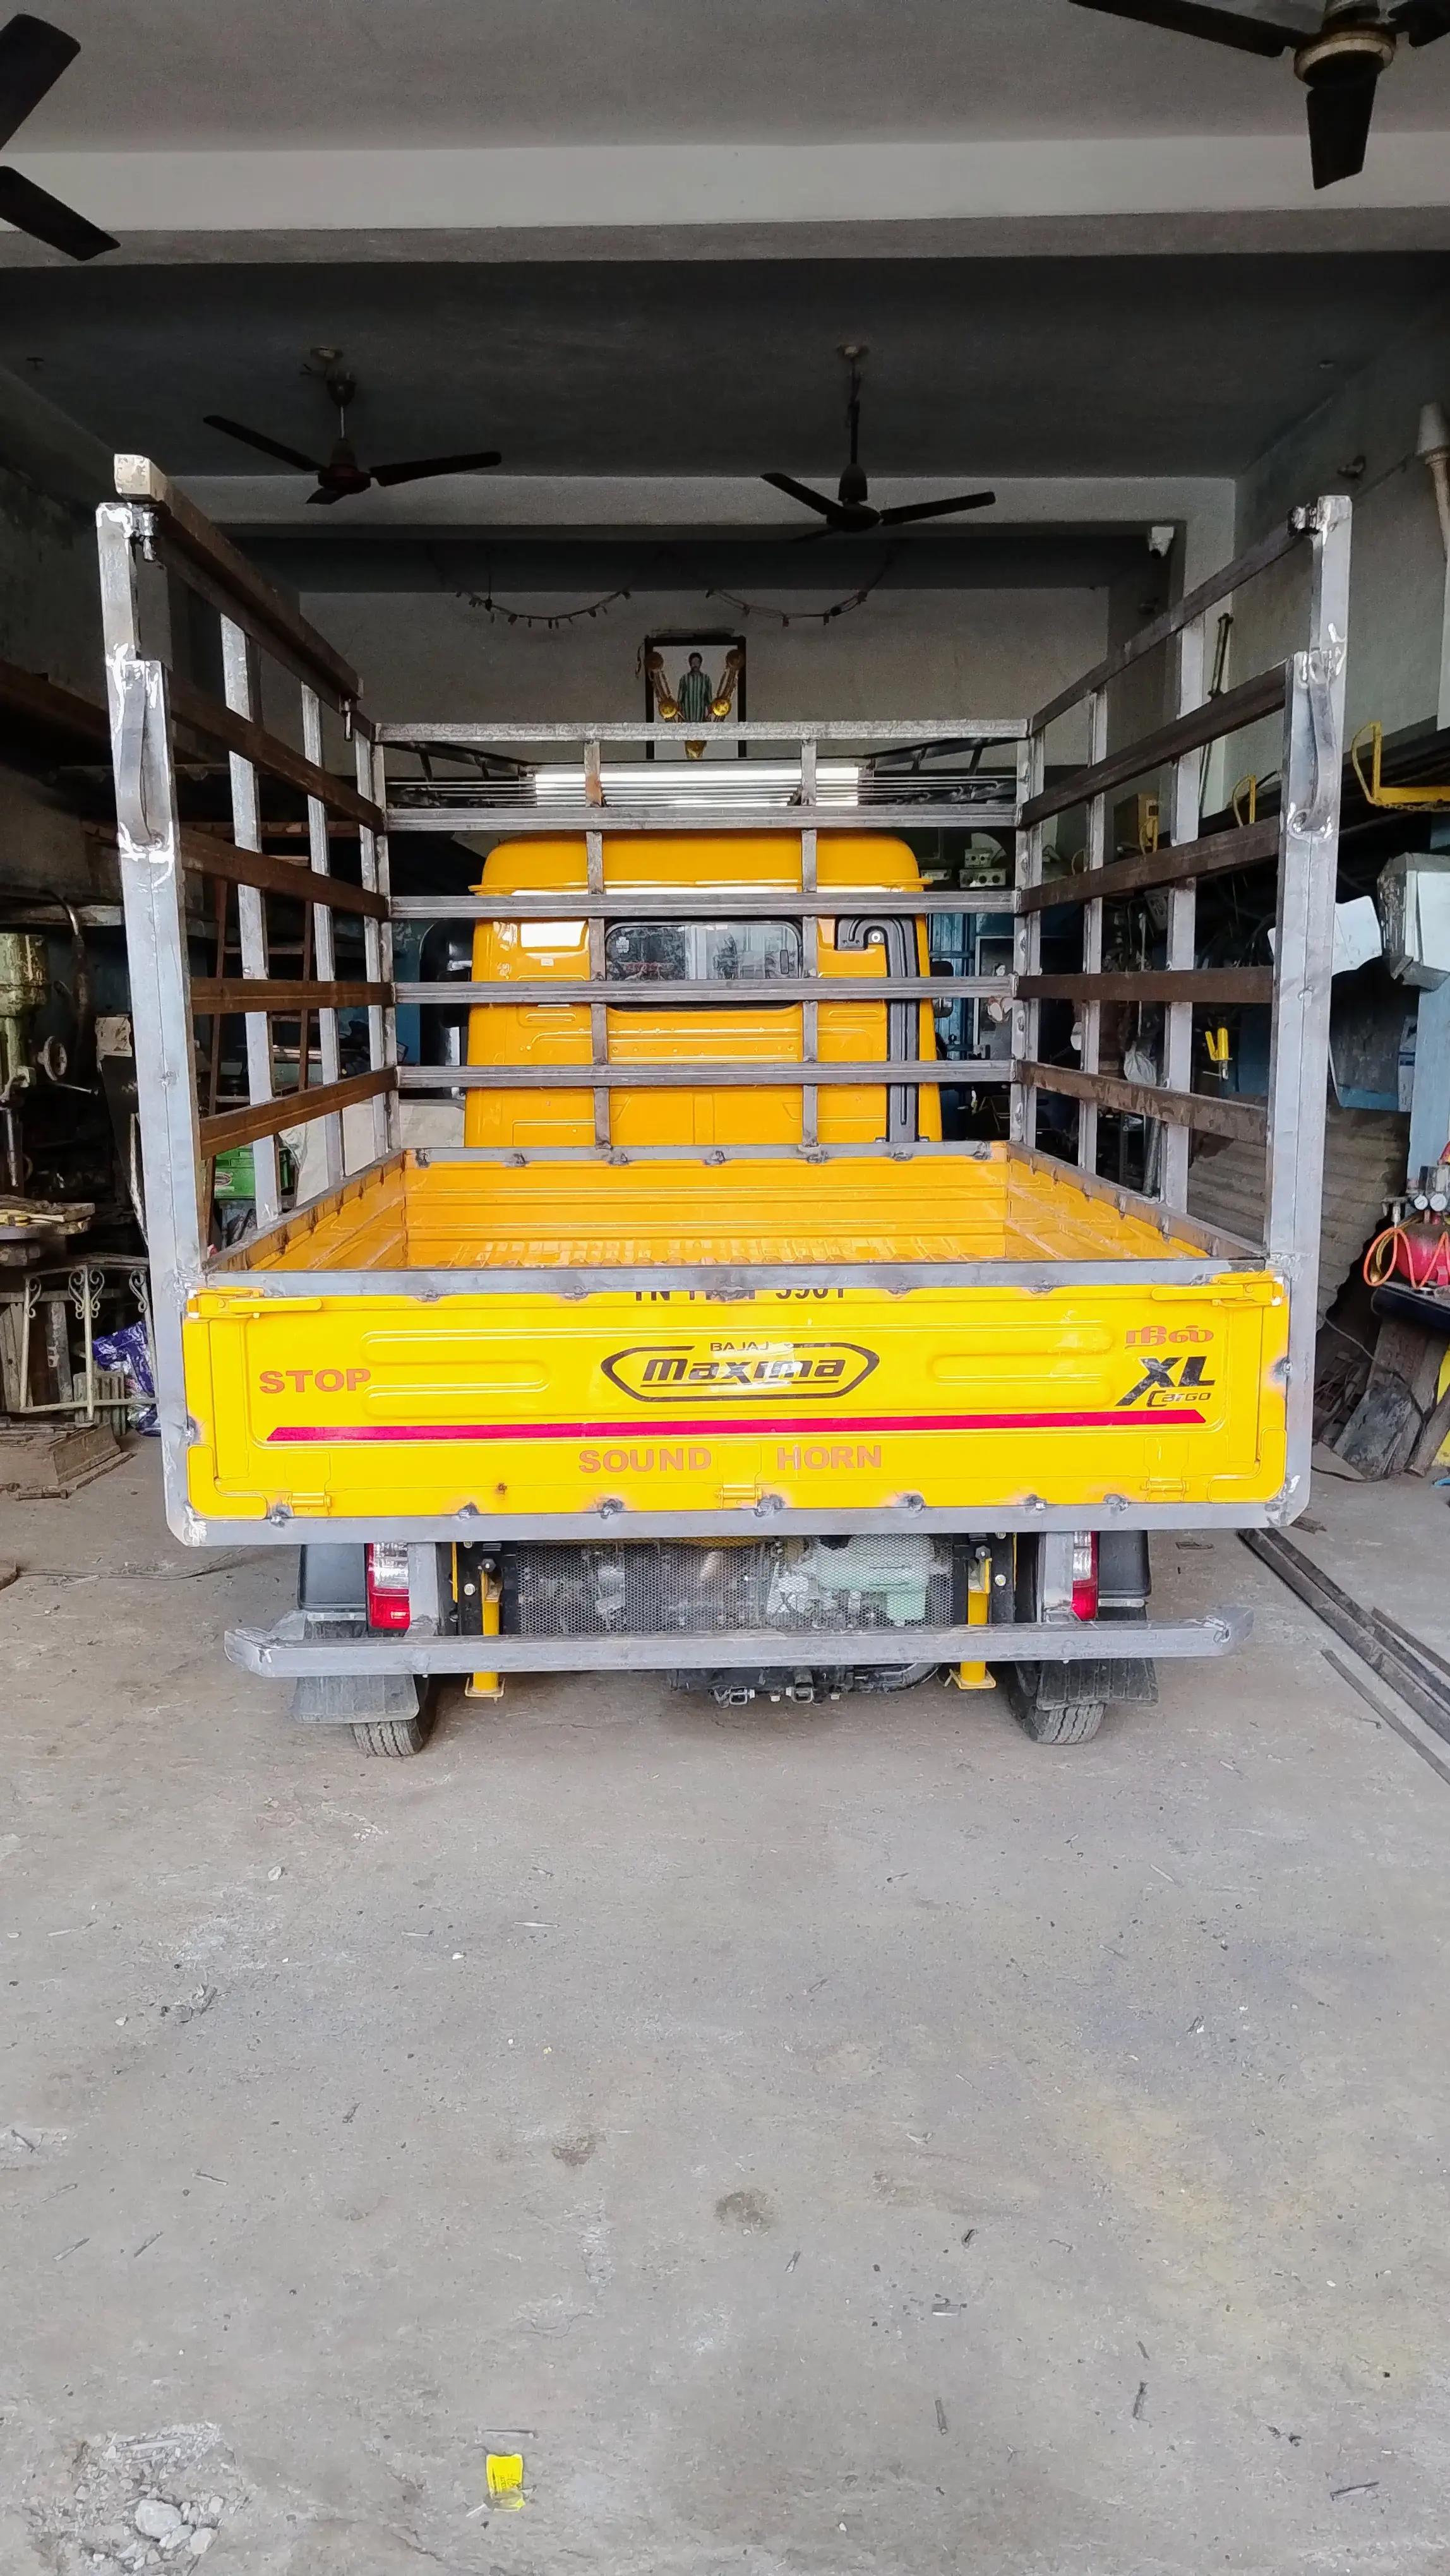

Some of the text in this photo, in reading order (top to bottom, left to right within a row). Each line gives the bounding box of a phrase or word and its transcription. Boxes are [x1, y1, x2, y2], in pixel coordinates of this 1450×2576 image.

[710, 1342, 770, 1352] BAJAJ
[1125, 1325, 1214, 1349] நில்
[260, 1368, 371, 1394] STOP
[1114, 1356, 1216, 1407] XL
[578, 1445, 882, 1473] SOUND HORN
